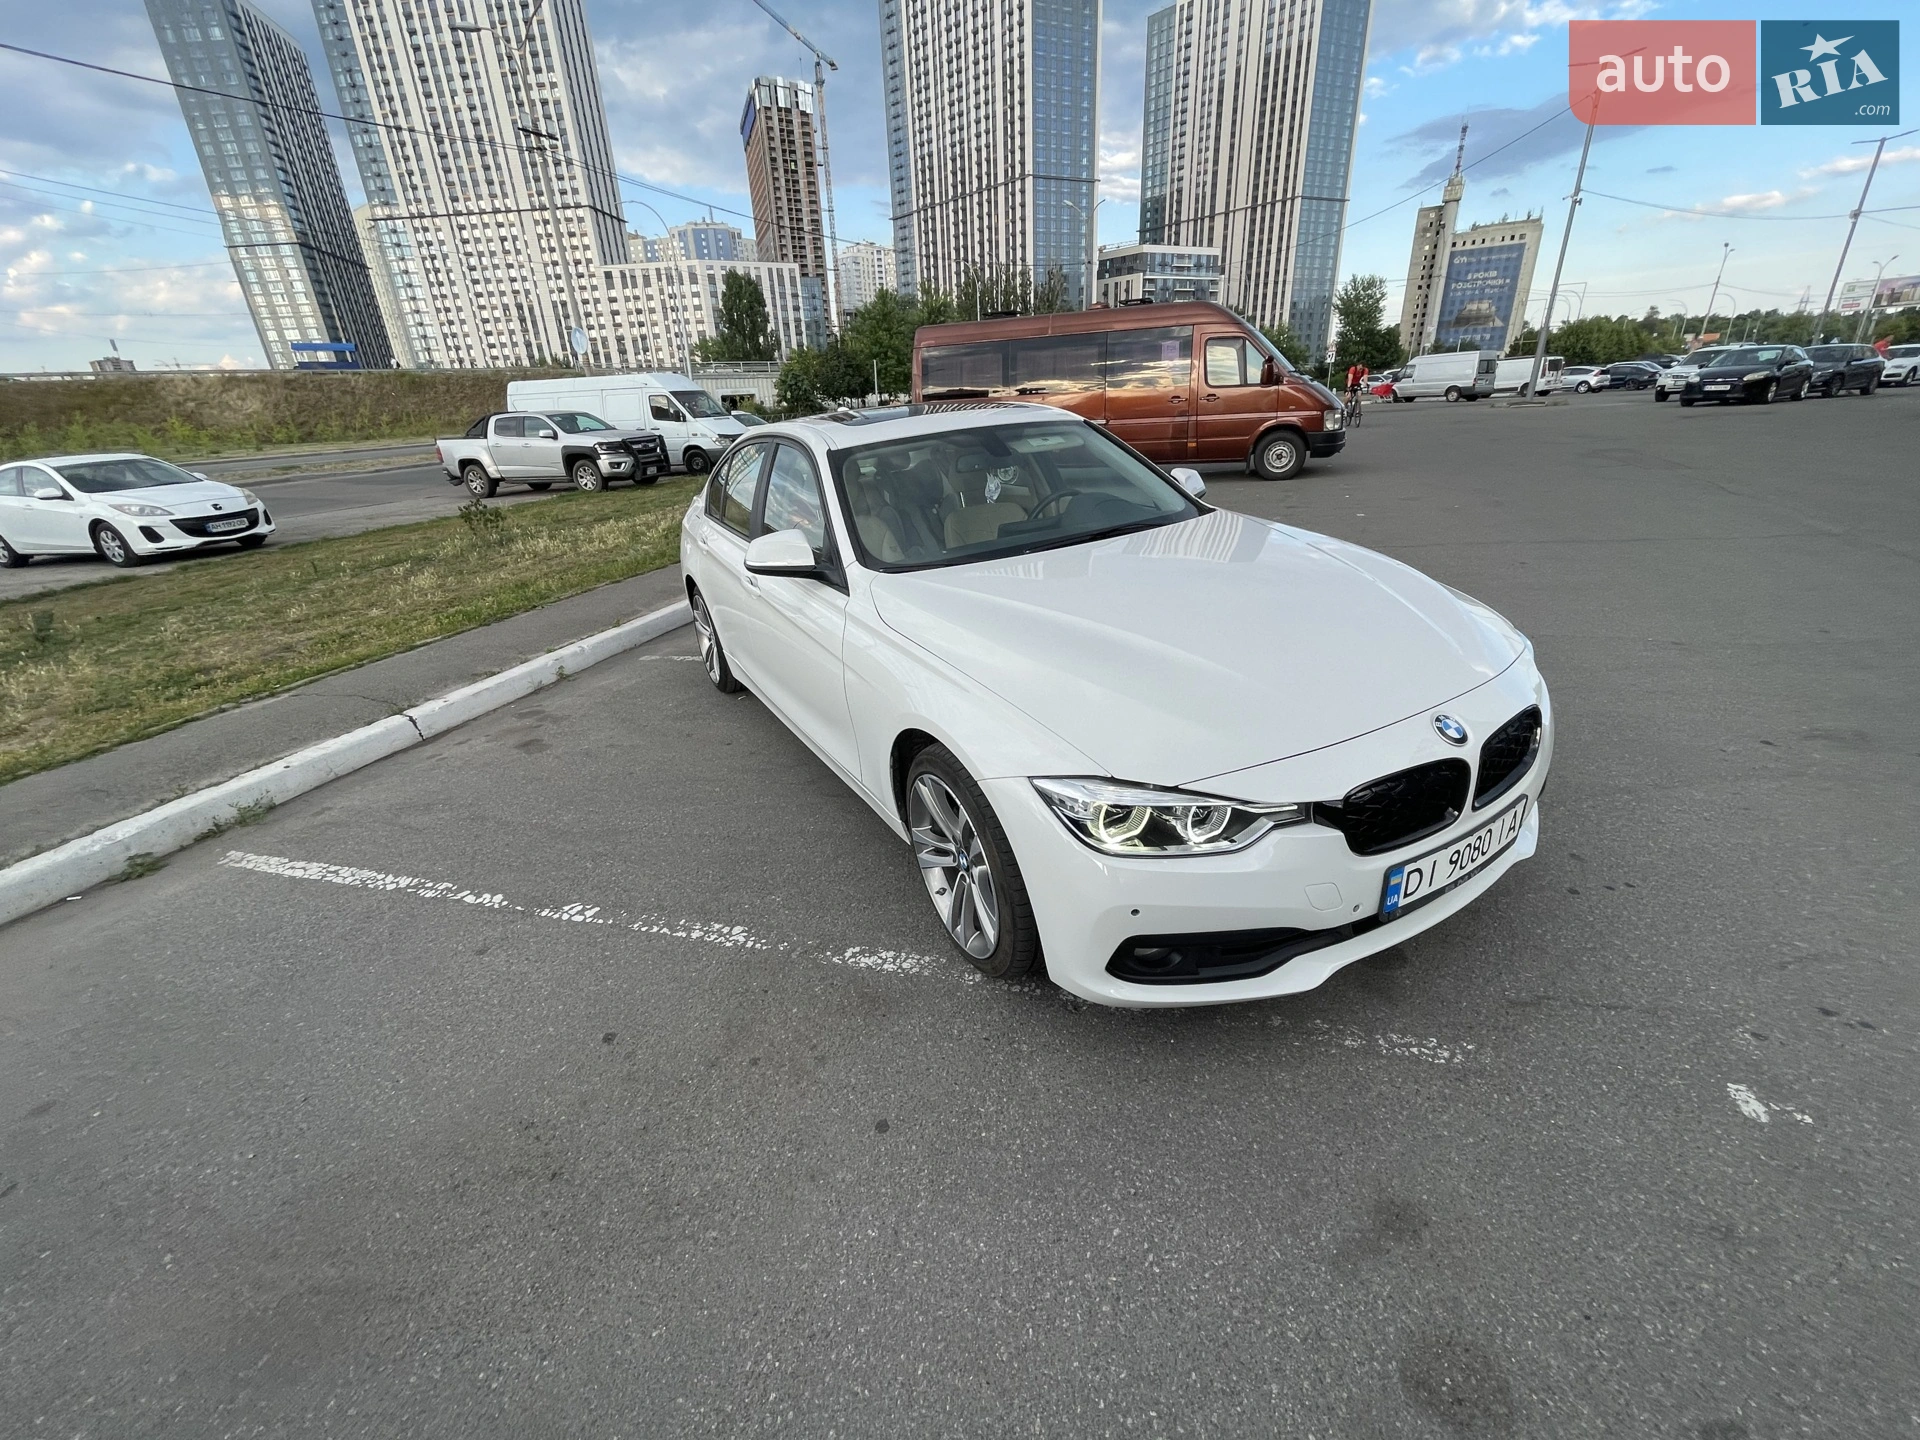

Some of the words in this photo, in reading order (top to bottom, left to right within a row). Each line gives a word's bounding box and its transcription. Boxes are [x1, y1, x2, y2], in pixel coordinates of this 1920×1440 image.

[1402, 859, 1437, 899] DI
[1446, 828, 1493, 880] 9080
[1498, 809, 1518, 846] IA
[1387, 894, 1399, 905] UA
